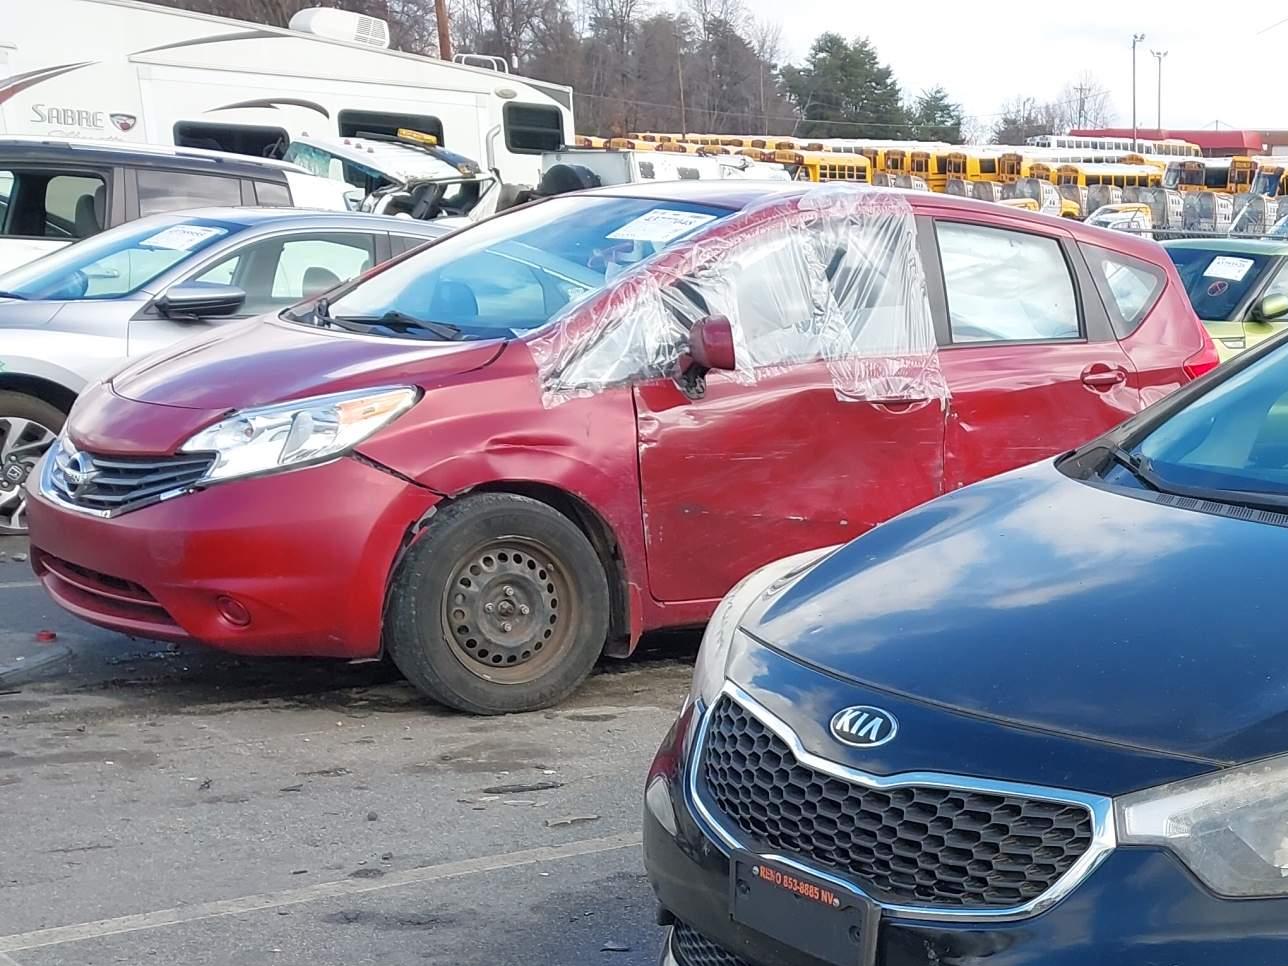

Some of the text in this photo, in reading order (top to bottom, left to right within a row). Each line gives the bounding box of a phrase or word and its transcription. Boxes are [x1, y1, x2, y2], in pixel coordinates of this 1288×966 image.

[30, 103, 105, 128] SABRE
[835, 708, 884, 742] KIA
[759, 865, 834, 905] RENO 853-8885 NV
